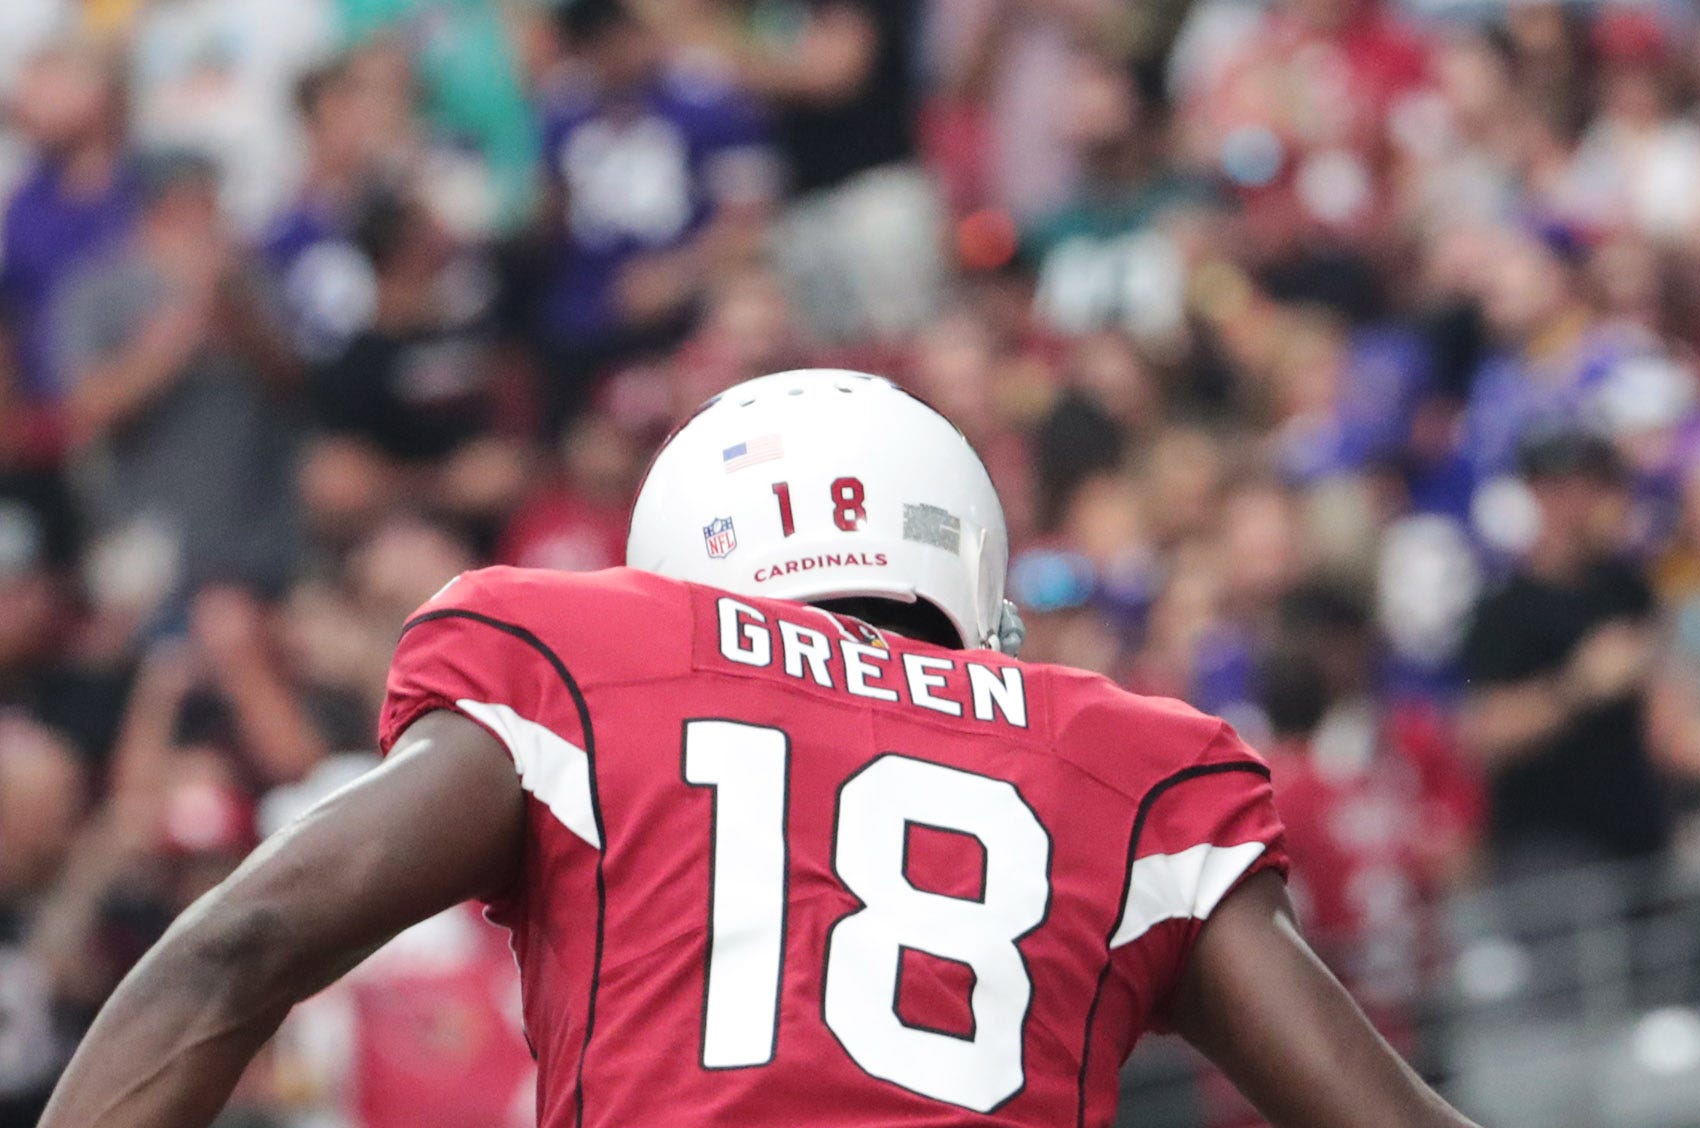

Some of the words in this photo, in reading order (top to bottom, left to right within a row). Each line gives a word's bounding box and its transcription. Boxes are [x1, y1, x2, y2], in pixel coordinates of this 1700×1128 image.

[771, 476, 868, 539] 18
[706, 536, 735, 557] NFL
[753, 553, 888, 583] CARDINALS
[716, 596, 1027, 728] GREEN
[681, 718, 1053, 1114] 18
